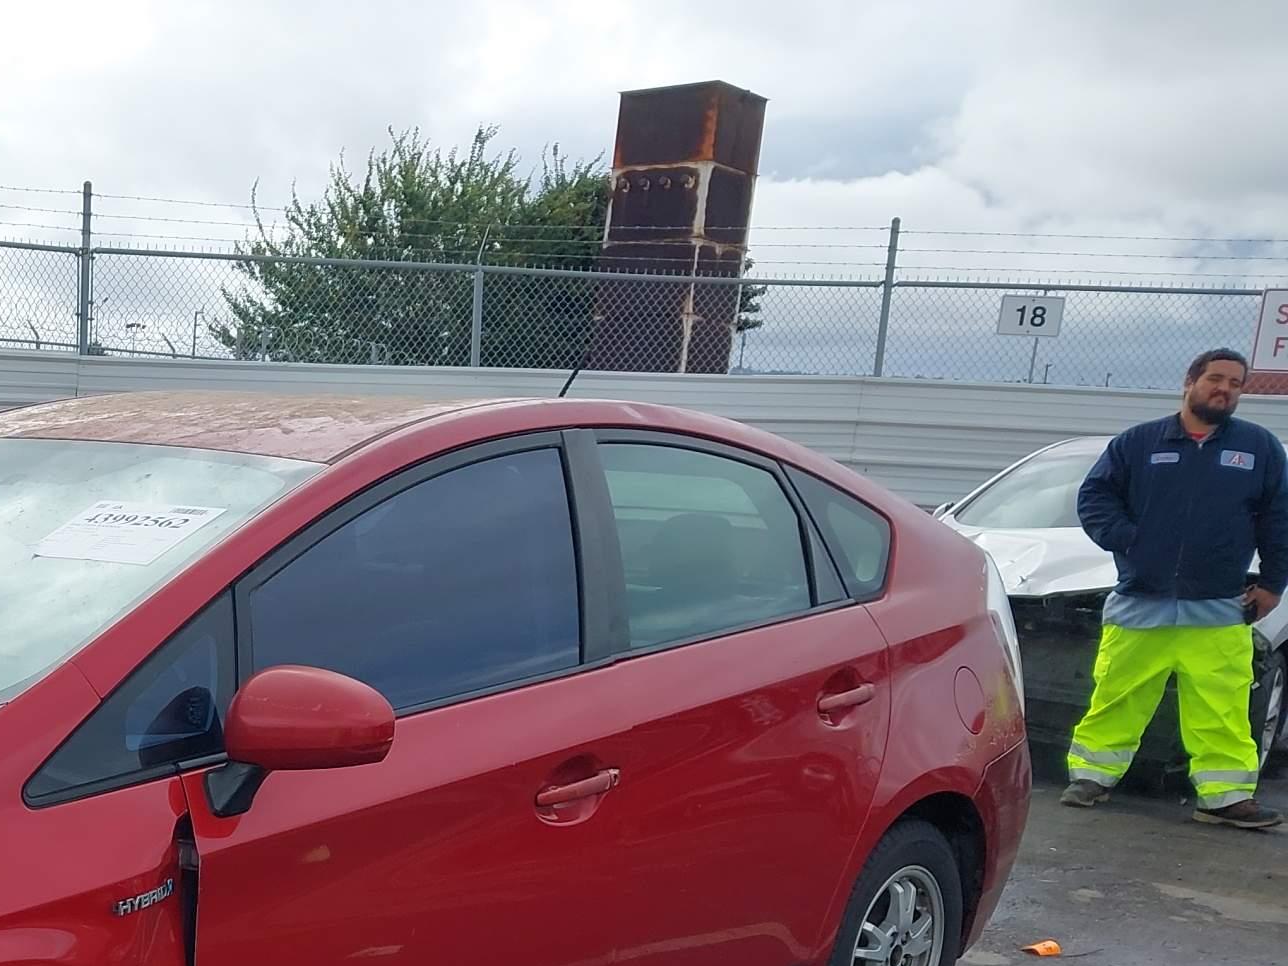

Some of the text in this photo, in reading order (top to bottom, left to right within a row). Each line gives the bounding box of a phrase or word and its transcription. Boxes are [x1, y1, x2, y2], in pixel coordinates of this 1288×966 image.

[1016, 305, 1047, 327] 18
[85, 512, 189, 529] 43992562
[118, 884, 168, 916] HYBRID
